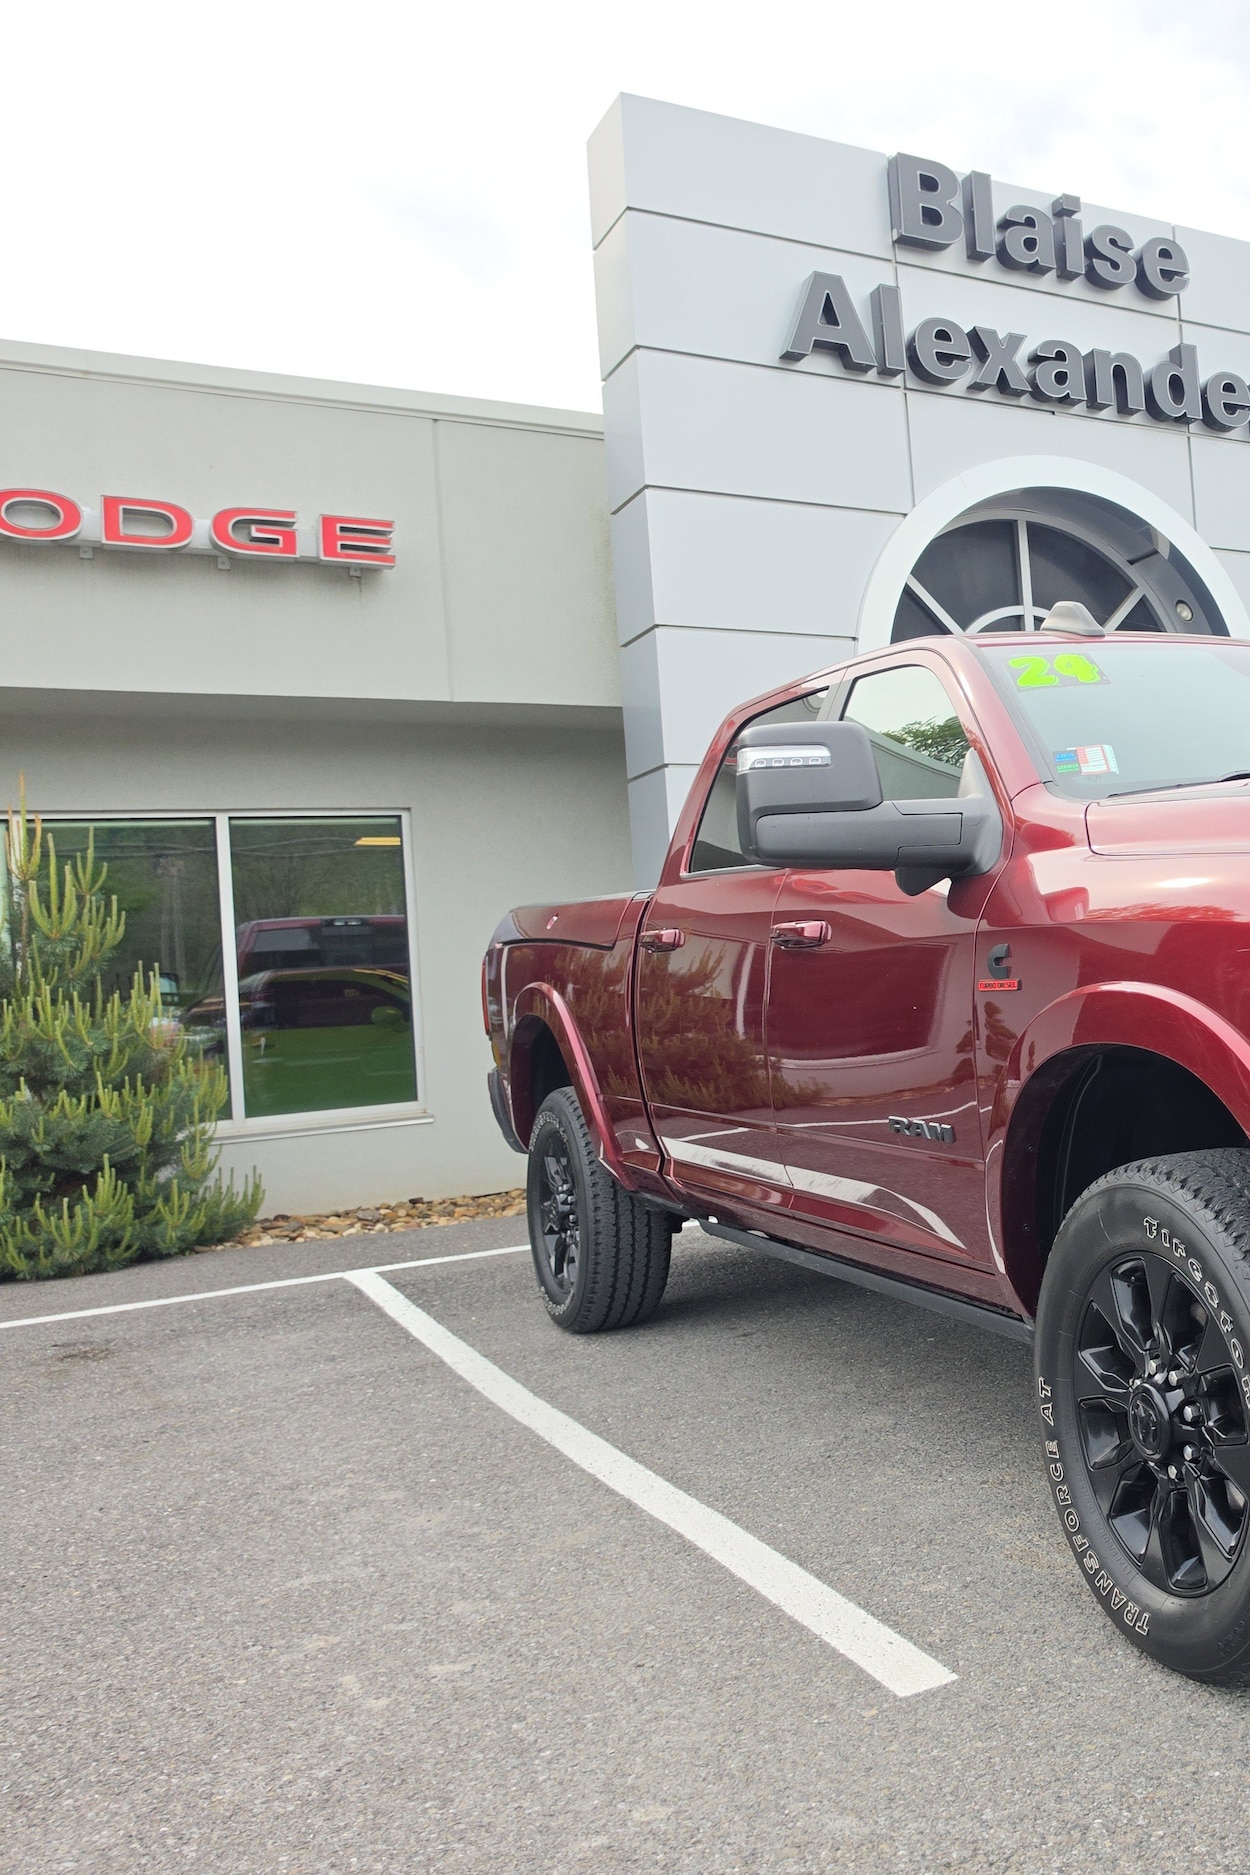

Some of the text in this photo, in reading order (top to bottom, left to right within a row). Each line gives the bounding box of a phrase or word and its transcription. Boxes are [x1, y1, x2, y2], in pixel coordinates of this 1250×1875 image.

[887, 152, 1190, 301] Blaise
[1008, 653, 1101, 688] 24
[888, 1116, 957, 1144] RAM
[1038, 1376, 1055, 1427] AT
[1045, 1440, 1151, 1636] TRANSFORCE
